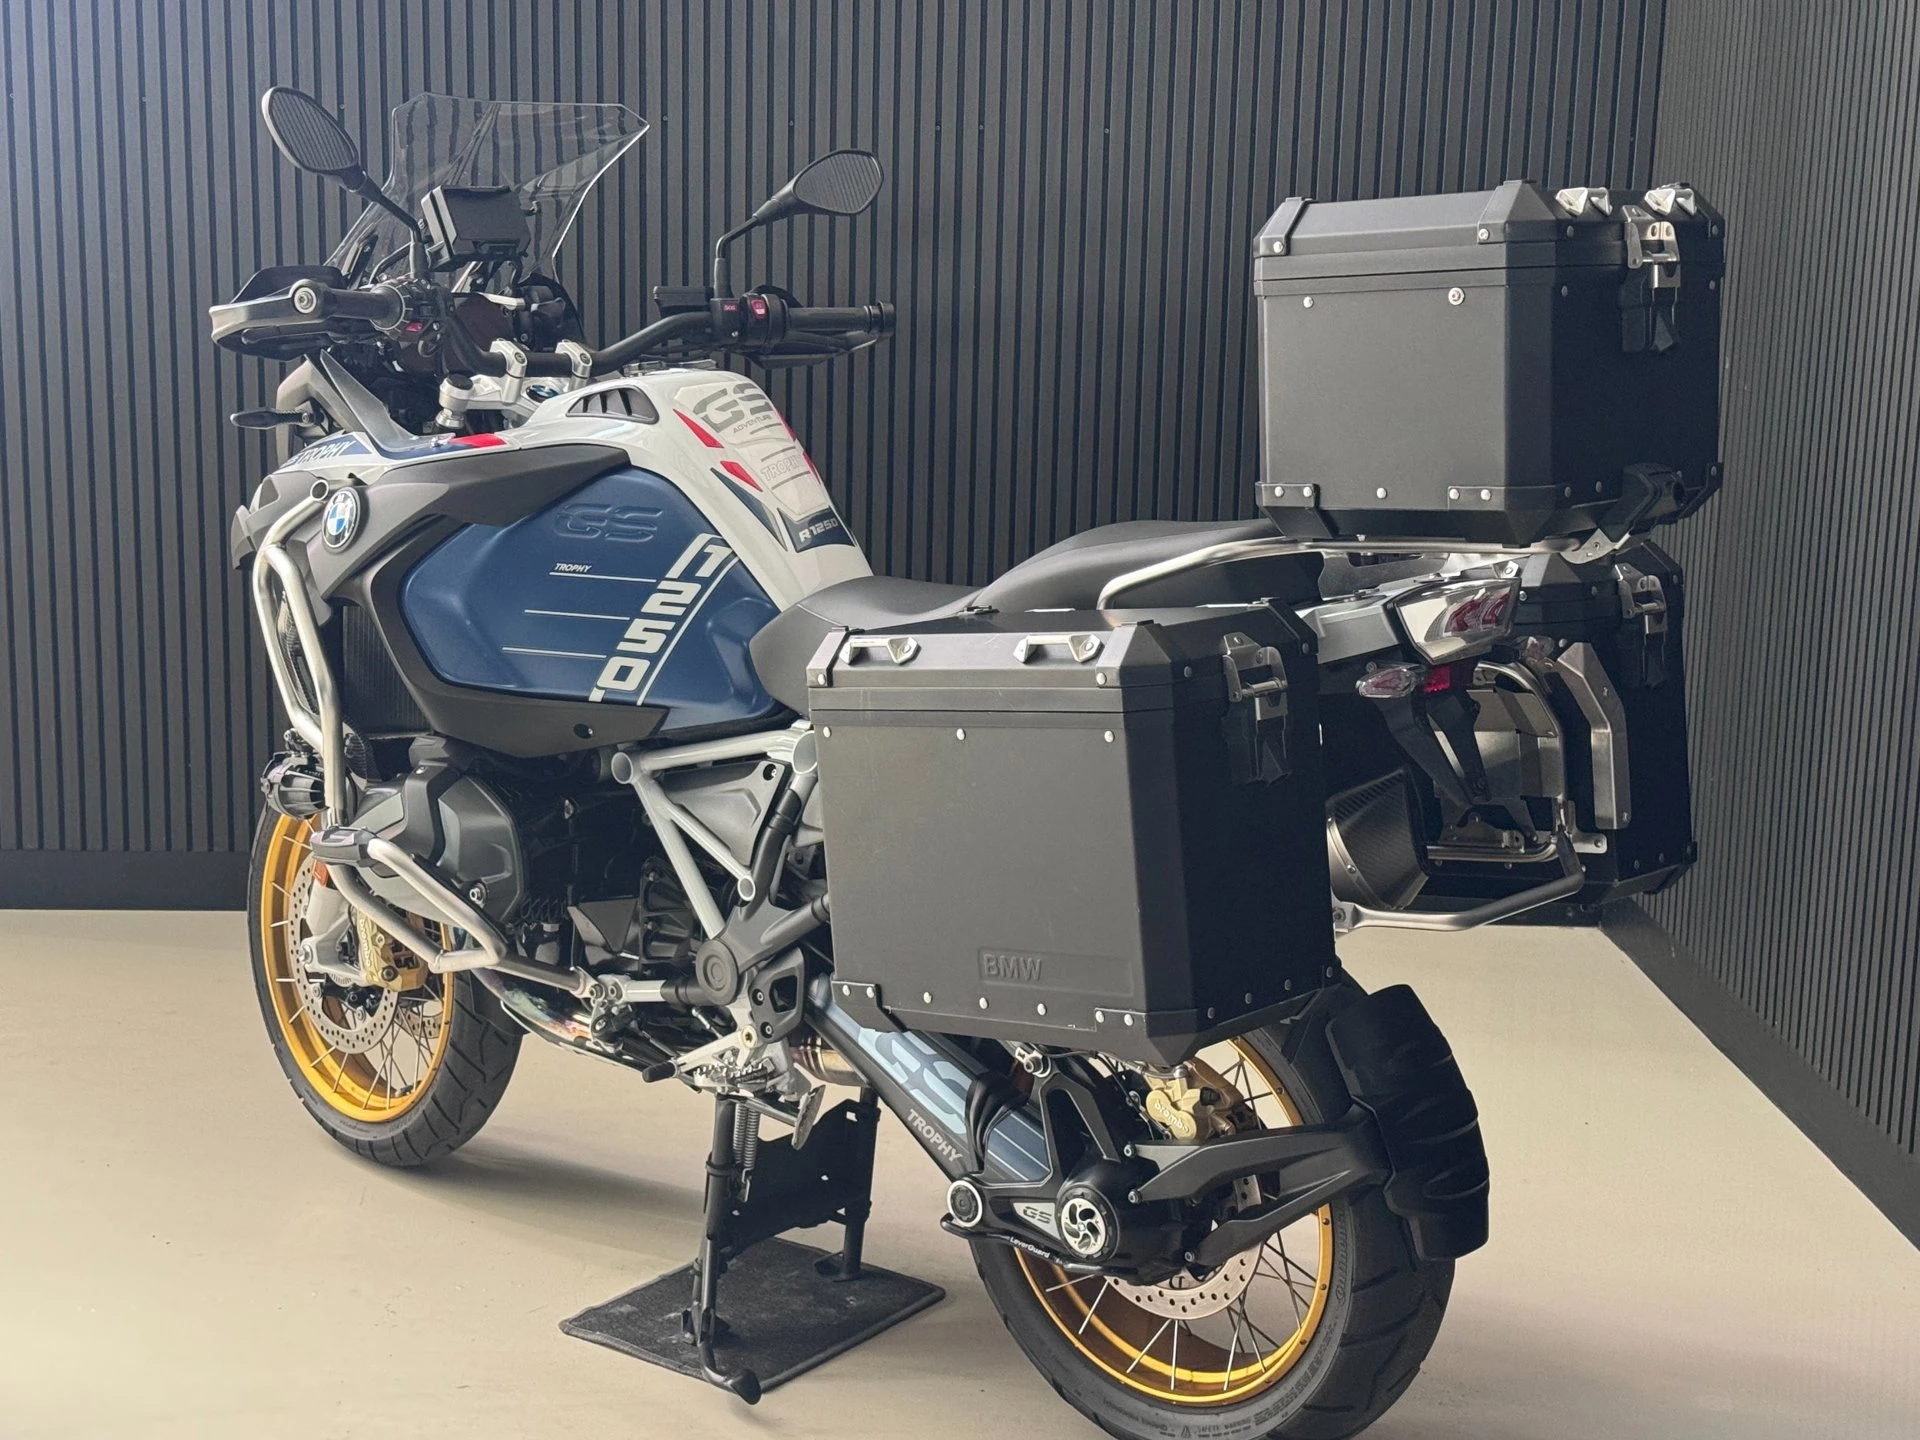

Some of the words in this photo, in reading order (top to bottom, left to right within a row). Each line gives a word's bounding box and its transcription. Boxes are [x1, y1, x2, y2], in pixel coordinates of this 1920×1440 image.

[553, 503, 664, 543] GS
[554, 563, 592, 573] TROPHY
[596, 544, 734, 691] 1250
[983, 953, 1042, 981] BMW
[1154, 1100, 1190, 1133] brembo
[907, 1108, 964, 1163] TROPHY
[1022, 1206, 1053, 1224] GS
[1009, 1236, 1051, 1259] LeverGuard
